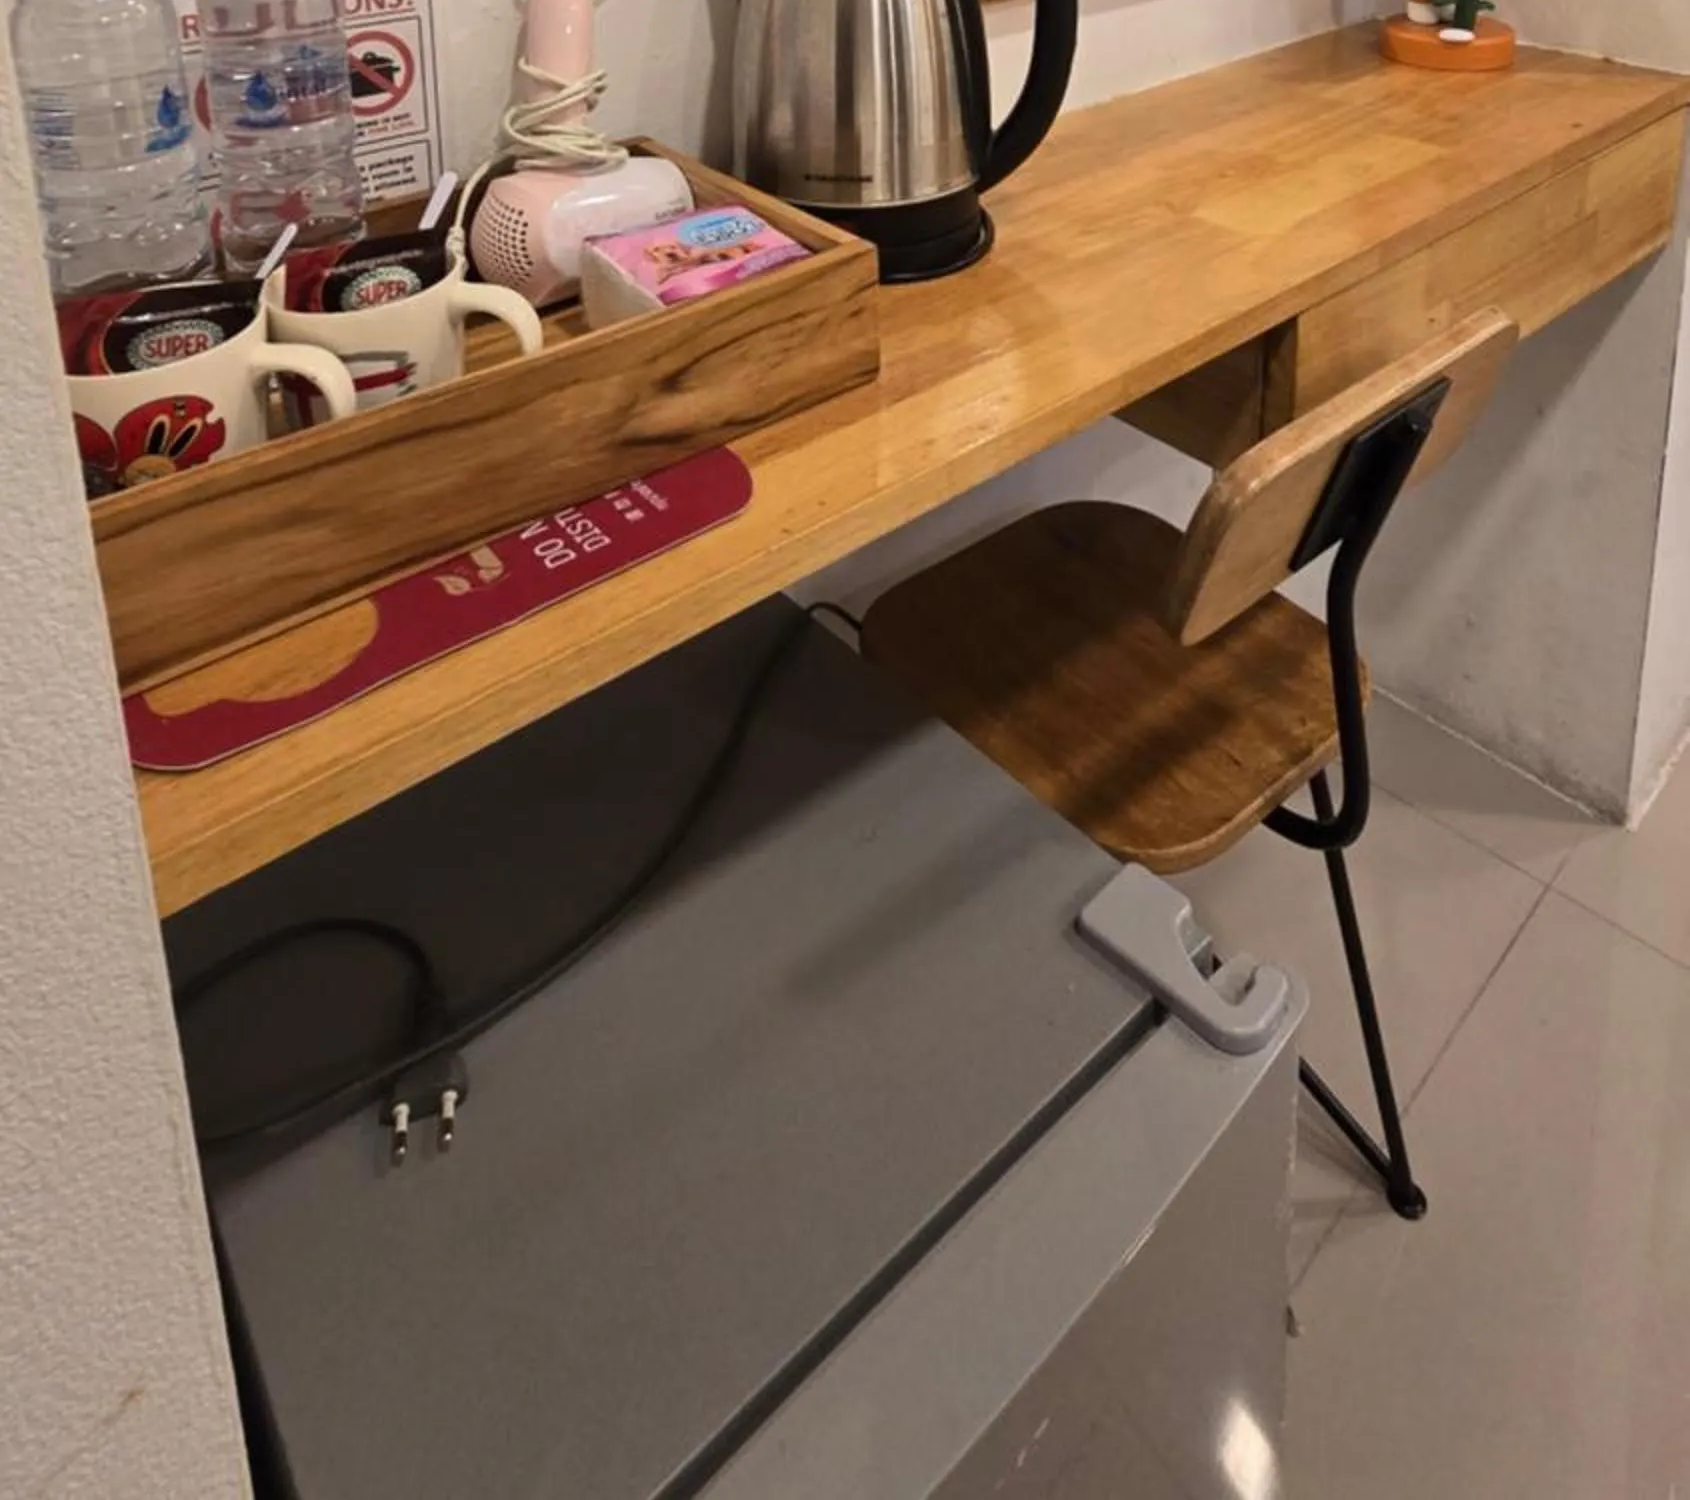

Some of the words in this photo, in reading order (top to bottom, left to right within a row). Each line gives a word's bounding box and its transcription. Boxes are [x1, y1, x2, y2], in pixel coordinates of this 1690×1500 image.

[355, 280, 409, 305] SUPER
[143, 333, 209, 358] SUPER
[533, 537, 577, 569] DO
